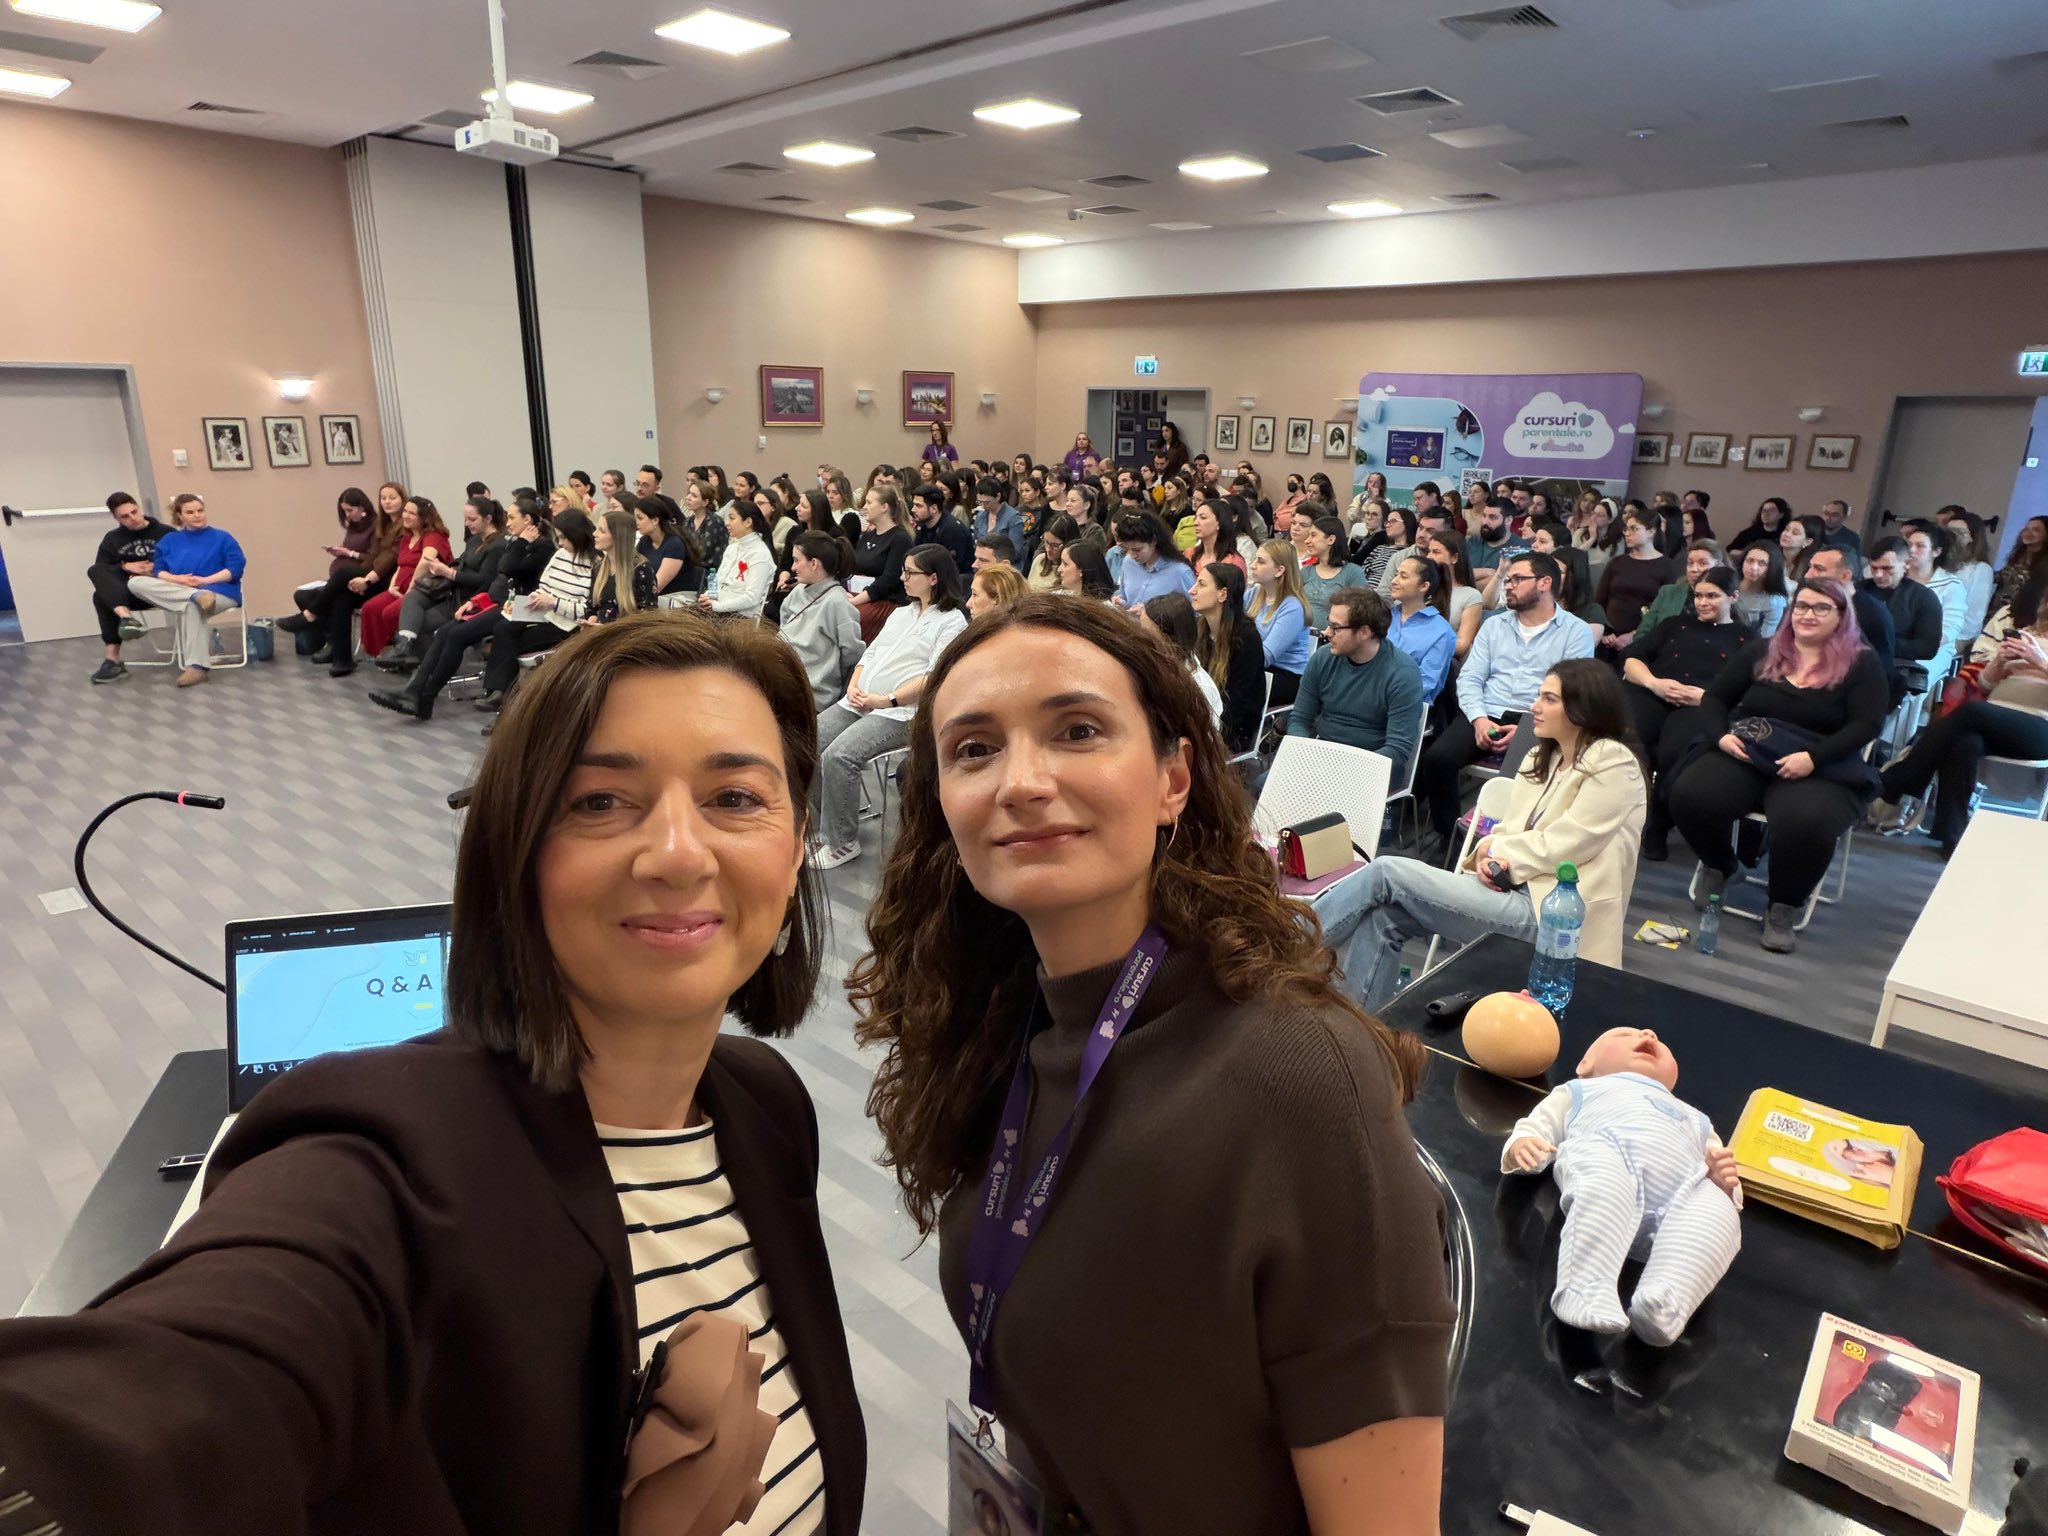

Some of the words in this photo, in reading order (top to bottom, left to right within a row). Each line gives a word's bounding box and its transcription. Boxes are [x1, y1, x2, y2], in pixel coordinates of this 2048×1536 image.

[1522, 427, 1593, 439] parentale.ro
[1524, 412, 1577, 426] cursuri
[366, 978, 385, 997] Q
[391, 976, 409, 994] &
[416, 974, 433, 991] A
[1113, 949, 1144, 1003] parentale.ro
[1127, 956, 1154, 997] cursuri
[985, 1174, 1002, 1217] cursuri
[1038, 1155, 1059, 1196] cursuri
